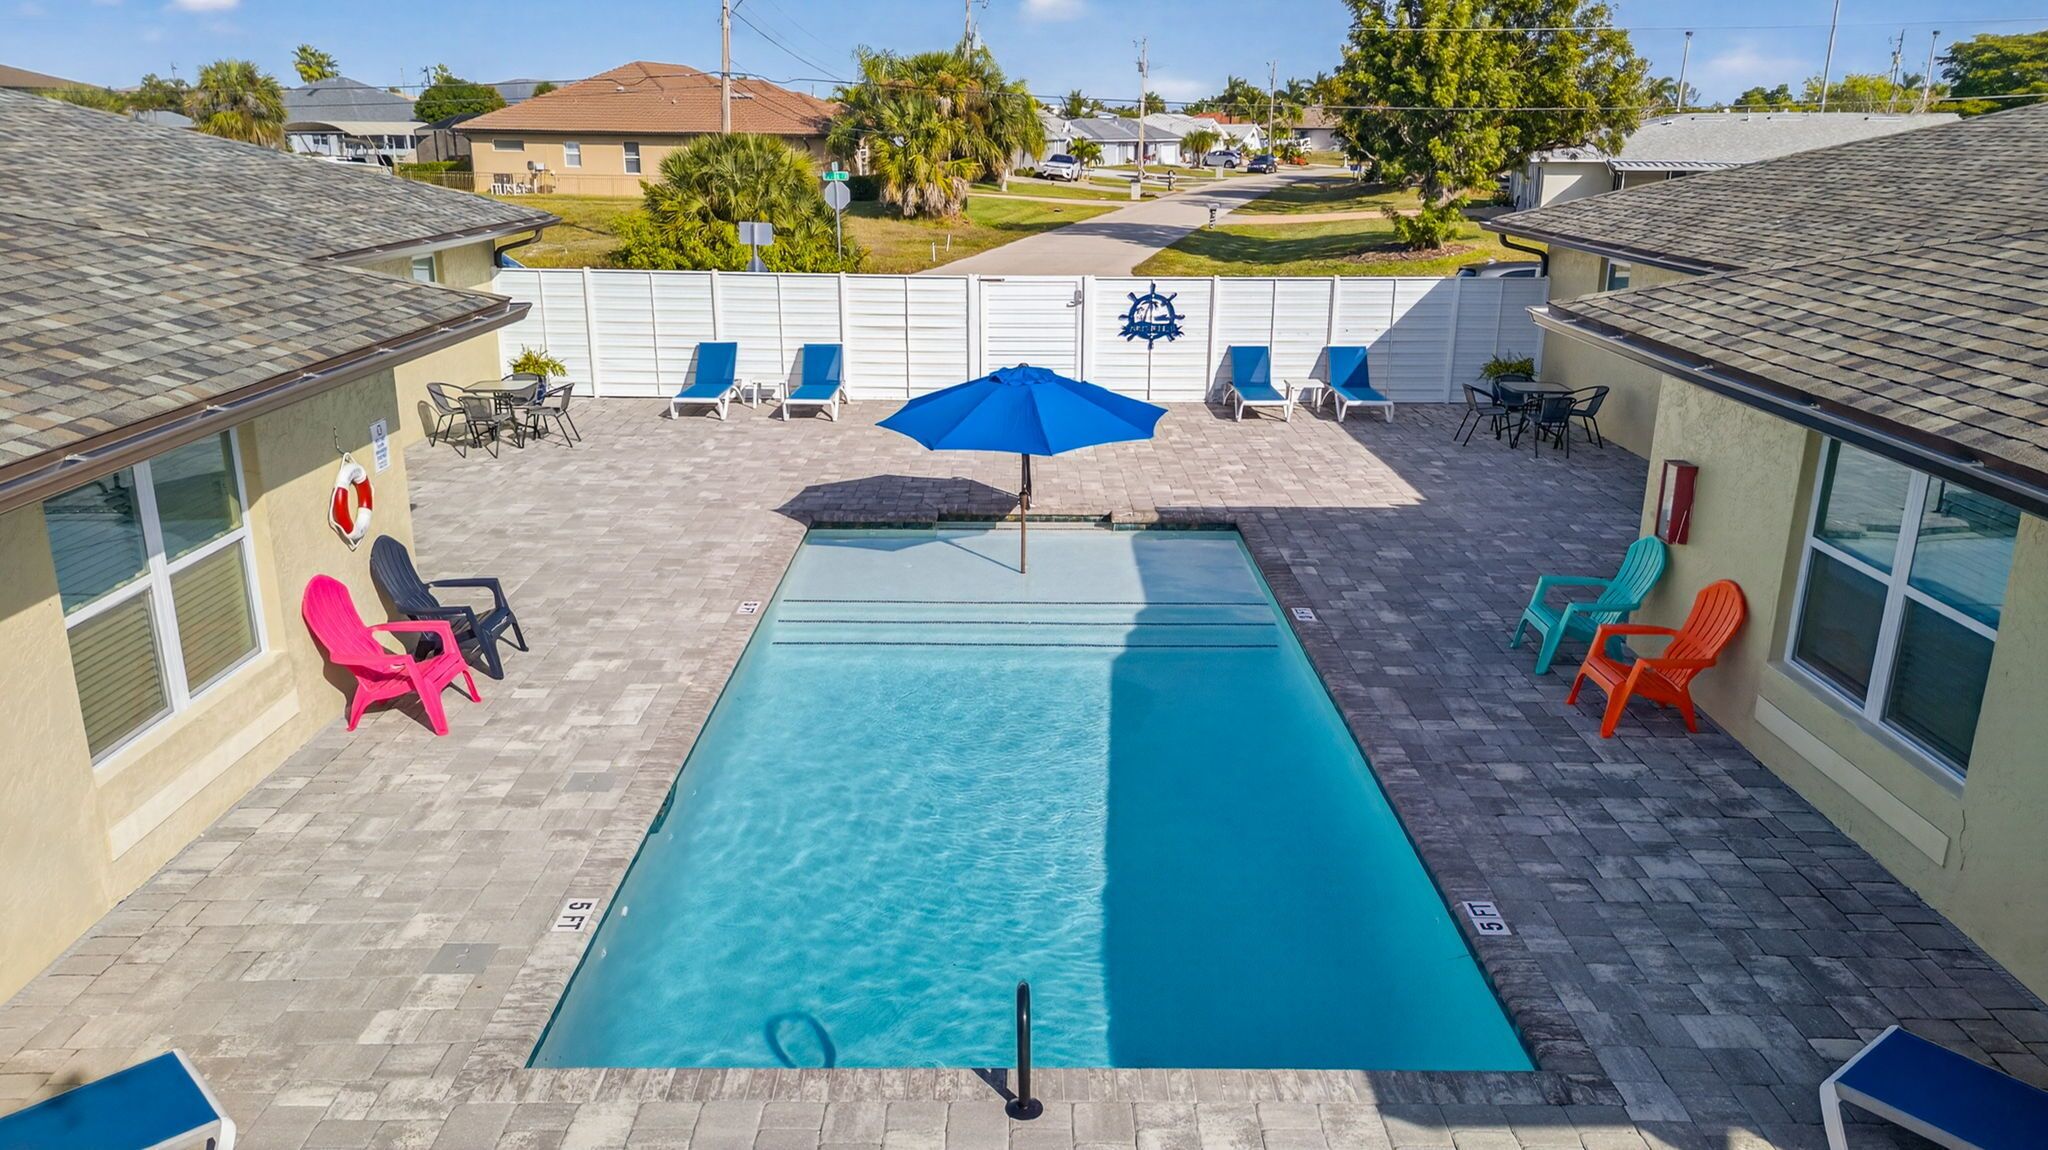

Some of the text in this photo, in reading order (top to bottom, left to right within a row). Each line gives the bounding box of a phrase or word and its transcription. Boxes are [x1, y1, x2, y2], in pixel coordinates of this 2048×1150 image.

[557, 902, 593, 930] 5 FT
[1467, 902, 1504, 931] 5 FT
